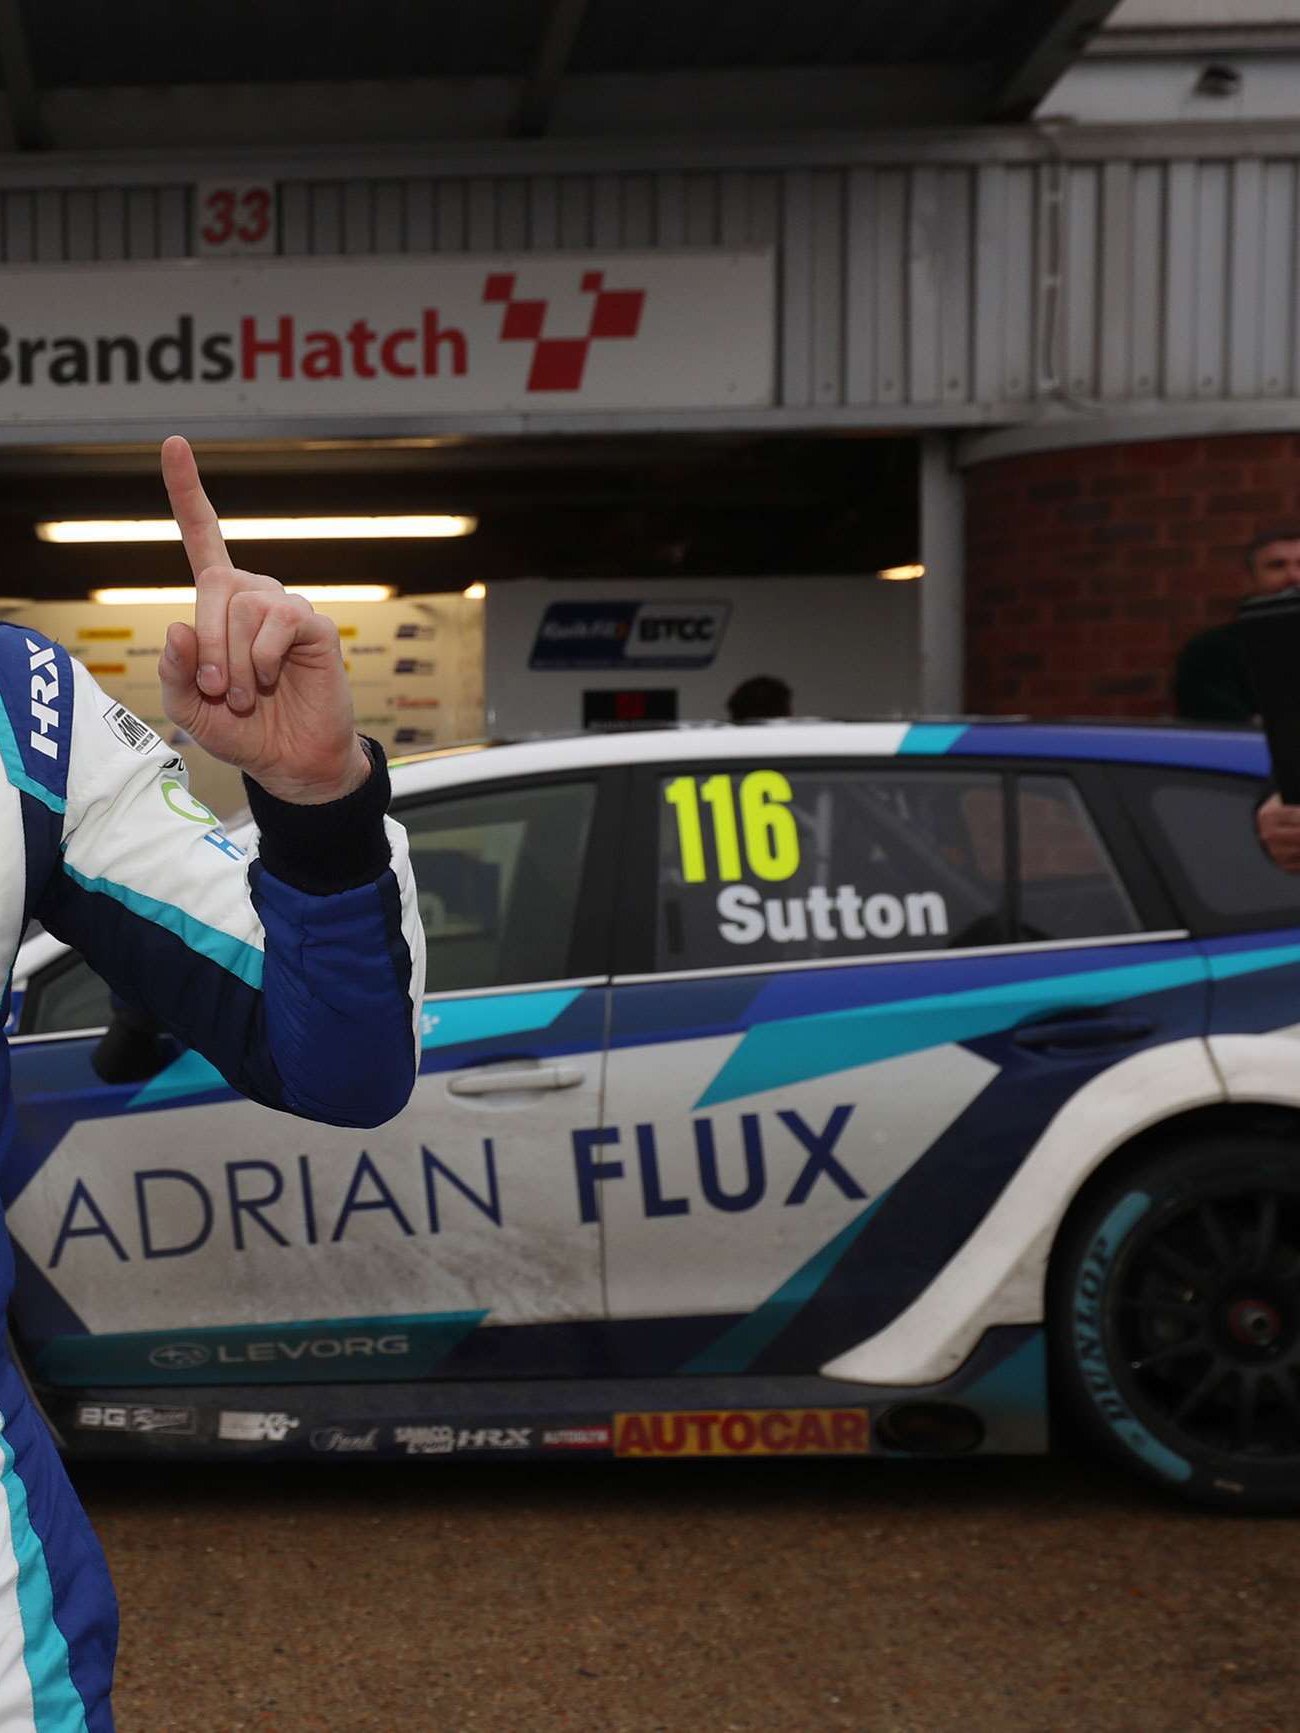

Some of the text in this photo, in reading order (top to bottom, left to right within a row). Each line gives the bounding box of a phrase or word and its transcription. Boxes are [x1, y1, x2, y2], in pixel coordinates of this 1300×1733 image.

[201, 189, 271, 245] 33
[25, 638, 60, 760] HRX
[664, 770, 800, 883] 116
[716, 884, 948, 944] Sutton
[46, 1105, 872, 1269] ADRIAN FLUX
[218, 1334, 410, 1363] LEVORG
[616, 1411, 867, 1455] AUTOCAR
